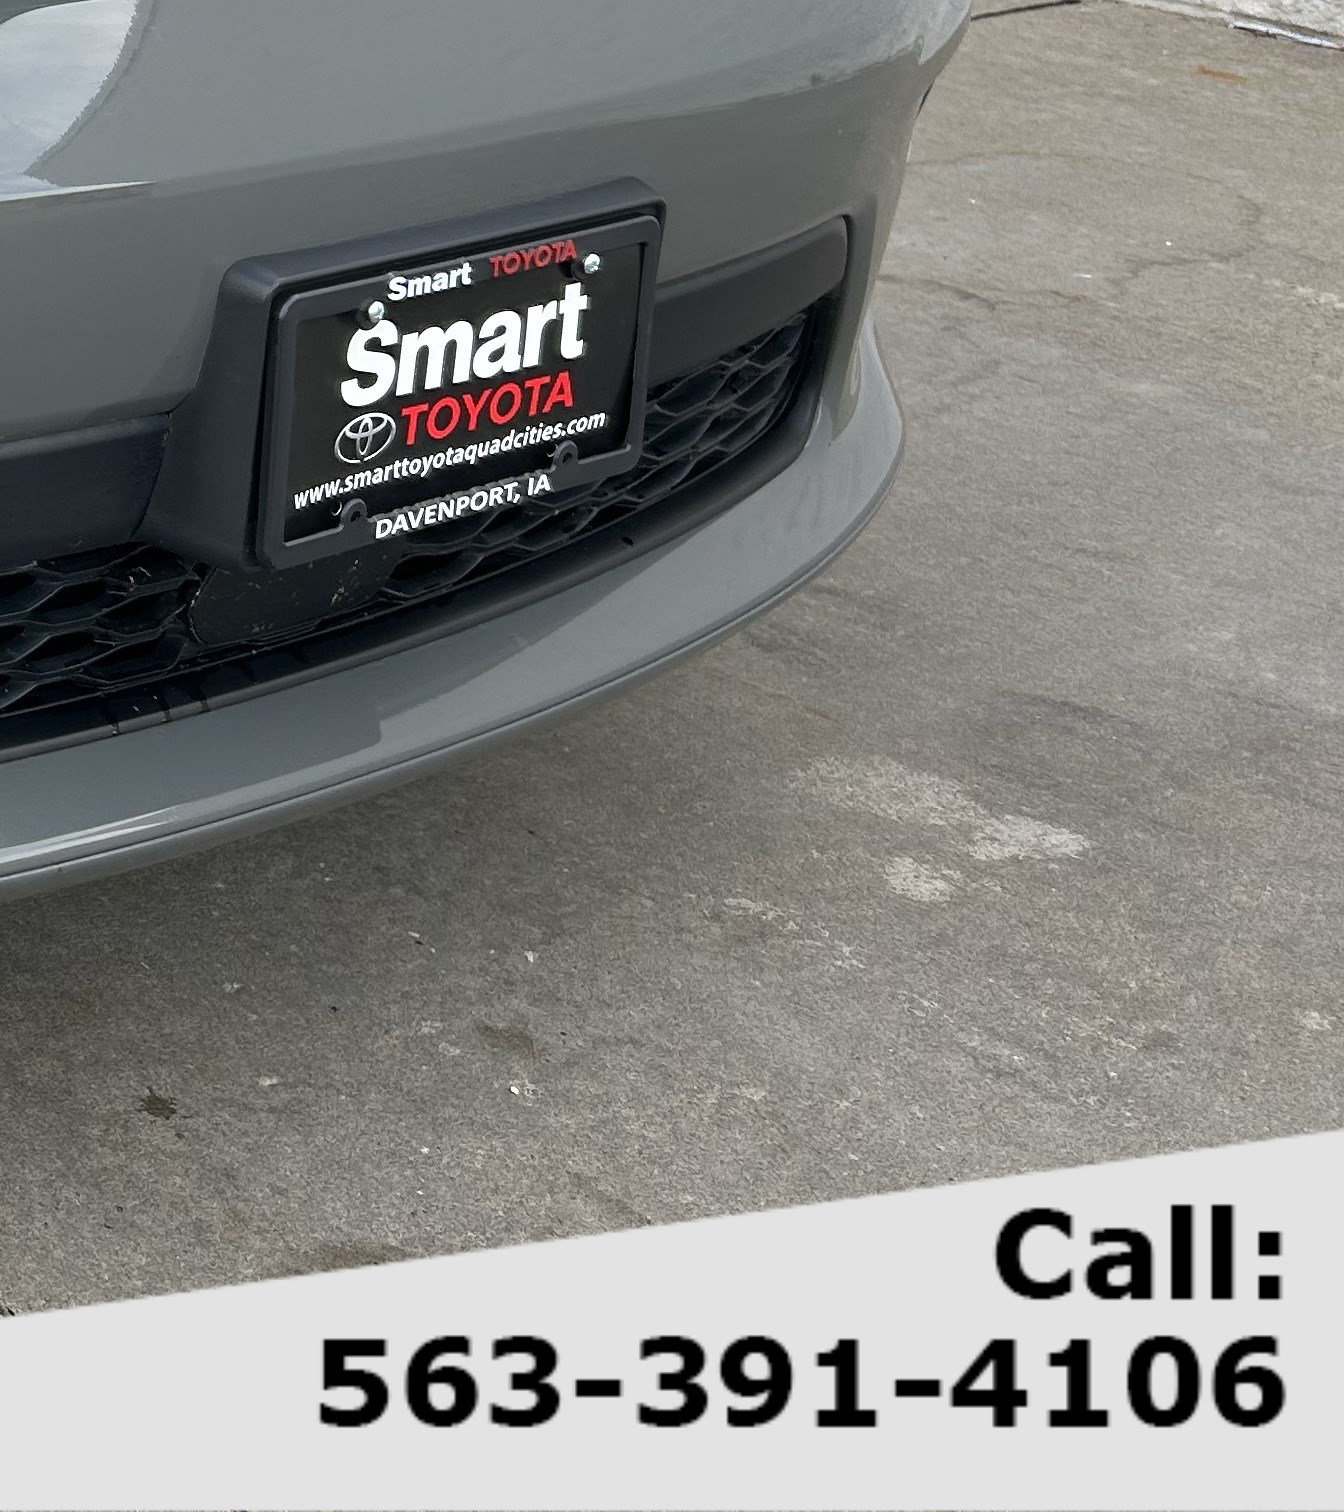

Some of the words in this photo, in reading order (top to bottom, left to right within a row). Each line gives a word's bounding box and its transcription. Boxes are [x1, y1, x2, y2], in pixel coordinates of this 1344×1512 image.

[387, 262, 473, 301] Smart
[488, 239, 578, 278] TOYOTA
[340, 282, 592, 408] Smart
[401, 370, 574, 446] TOYOTA
[293, 411, 607, 511] www.smarttoyotaquadcities.com
[375, 484, 521, 540] DAVENPORT,
[527, 474, 552, 498] IA
